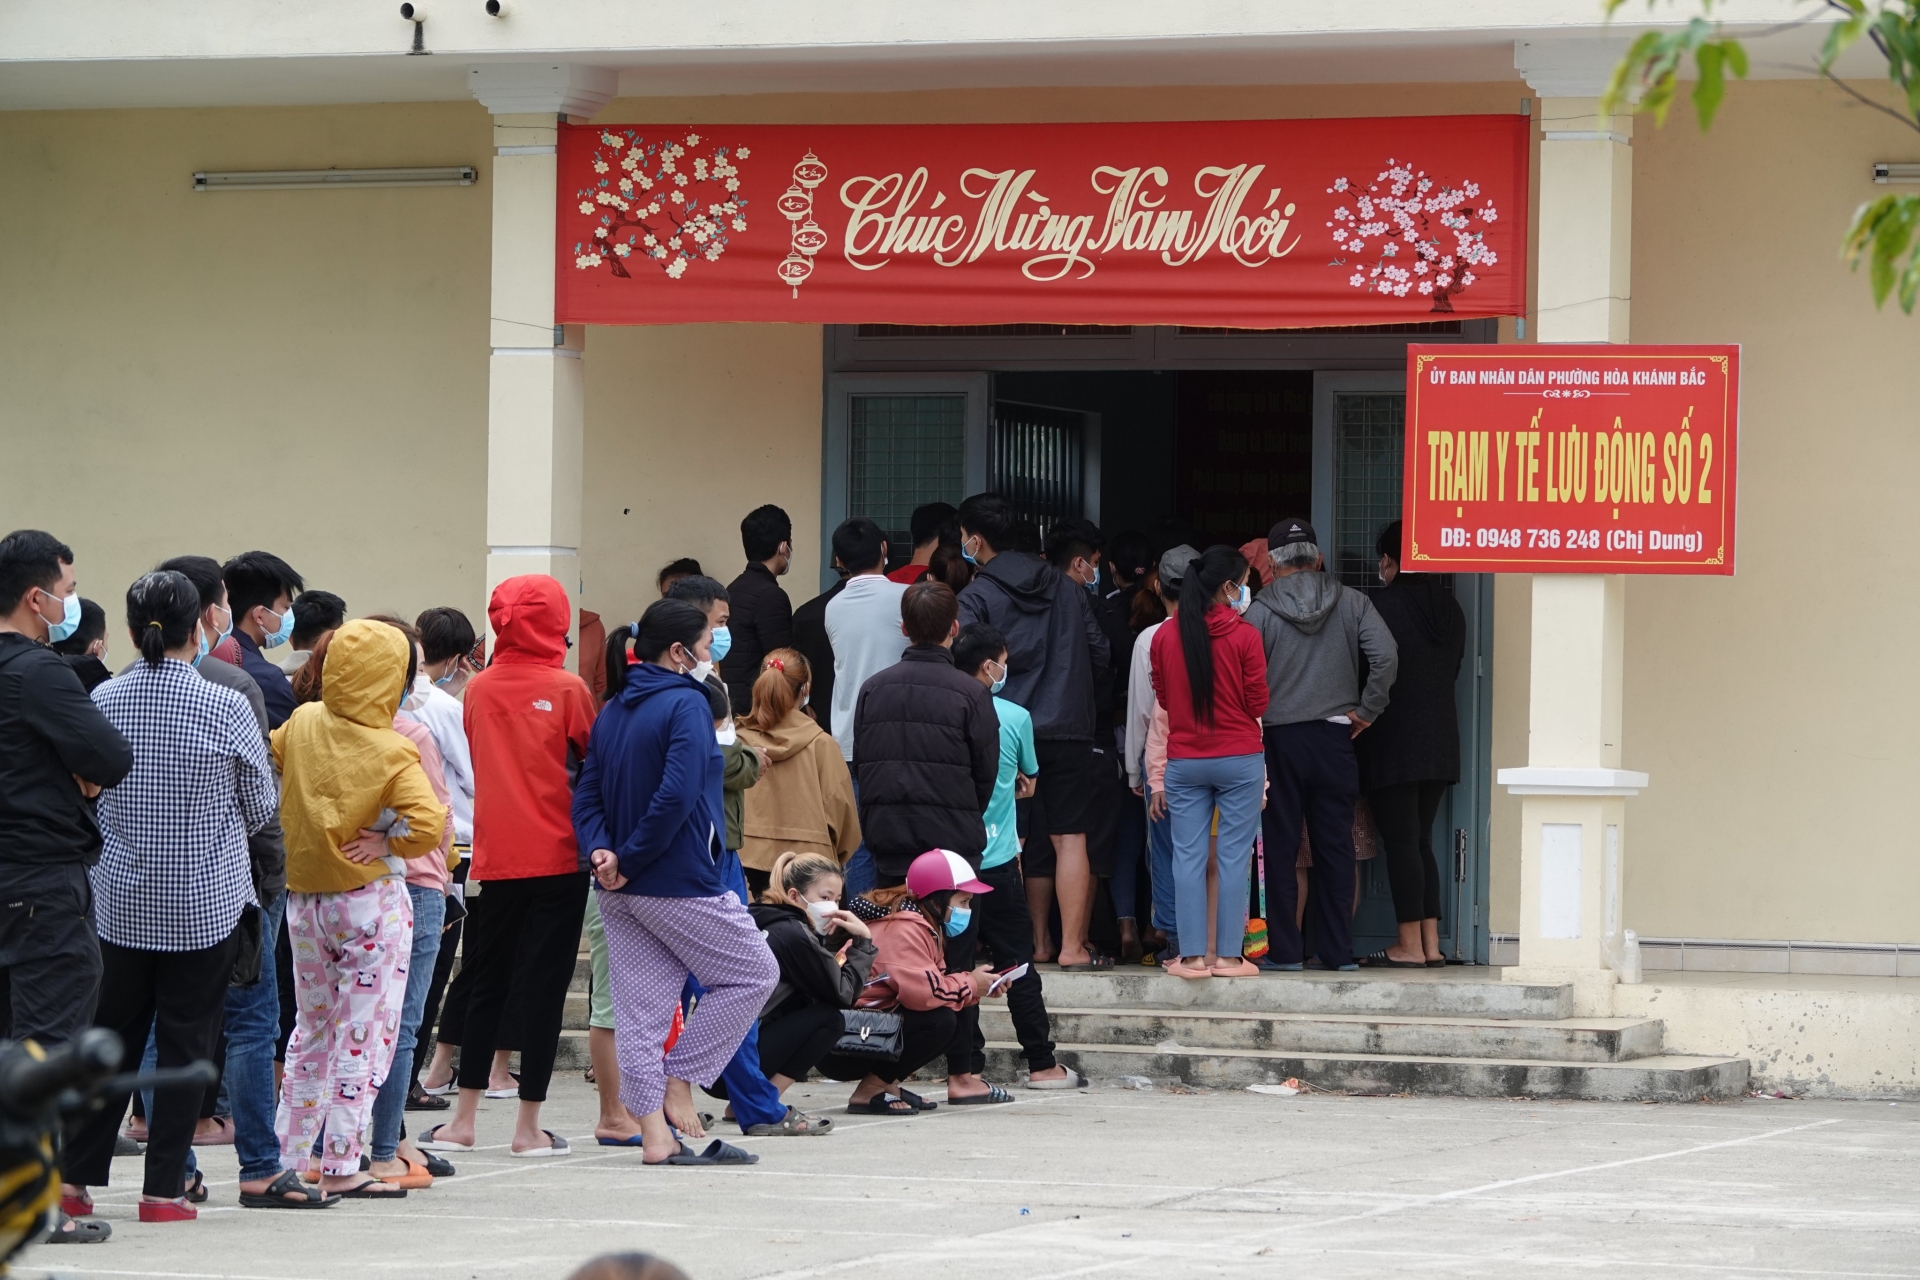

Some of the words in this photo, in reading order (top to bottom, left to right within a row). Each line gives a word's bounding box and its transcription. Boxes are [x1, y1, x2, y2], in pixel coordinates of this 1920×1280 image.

[839, 166, 966, 270] Chúc
[934, 168, 1095, 281] Mừng
[1088, 166, 1197, 256] Năm
[1162, 163, 1302, 267] Mới
[1430, 366, 1447, 385] ỦY
[1450, 370, 1476, 385] BAN
[1479, 368, 1515, 385] NHÂN
[1518, 368, 1545, 385] DÂN
[1548, 368, 1600, 385] PHƯỜNG
[1603, 368, 1629, 385] HÒA
[1632, 369, 1677, 385] KHÁNH
[1680, 366, 1706, 385] BẮC
[1428, 431, 1489, 518] TRẠM
[1496, 431, 1510, 502] Y
[1515, 407, 1544, 502] TẾ
[1546, 424, 1589, 504] LƯU
[1594, 416, 1656, 520] ĐỘNG
[1662, 405, 1694, 505] SỐ
[1698, 432, 1713, 504] 2
[1440, 527, 1471, 547] DĐ:
[1476, 528, 1522, 548] 0948
[1526, 529, 1561, 549] 736
[1565, 529, 1601, 549] 248
[1606, 530, 1643, 554] (Chị
[1649, 530, 1703, 552] Dung)
